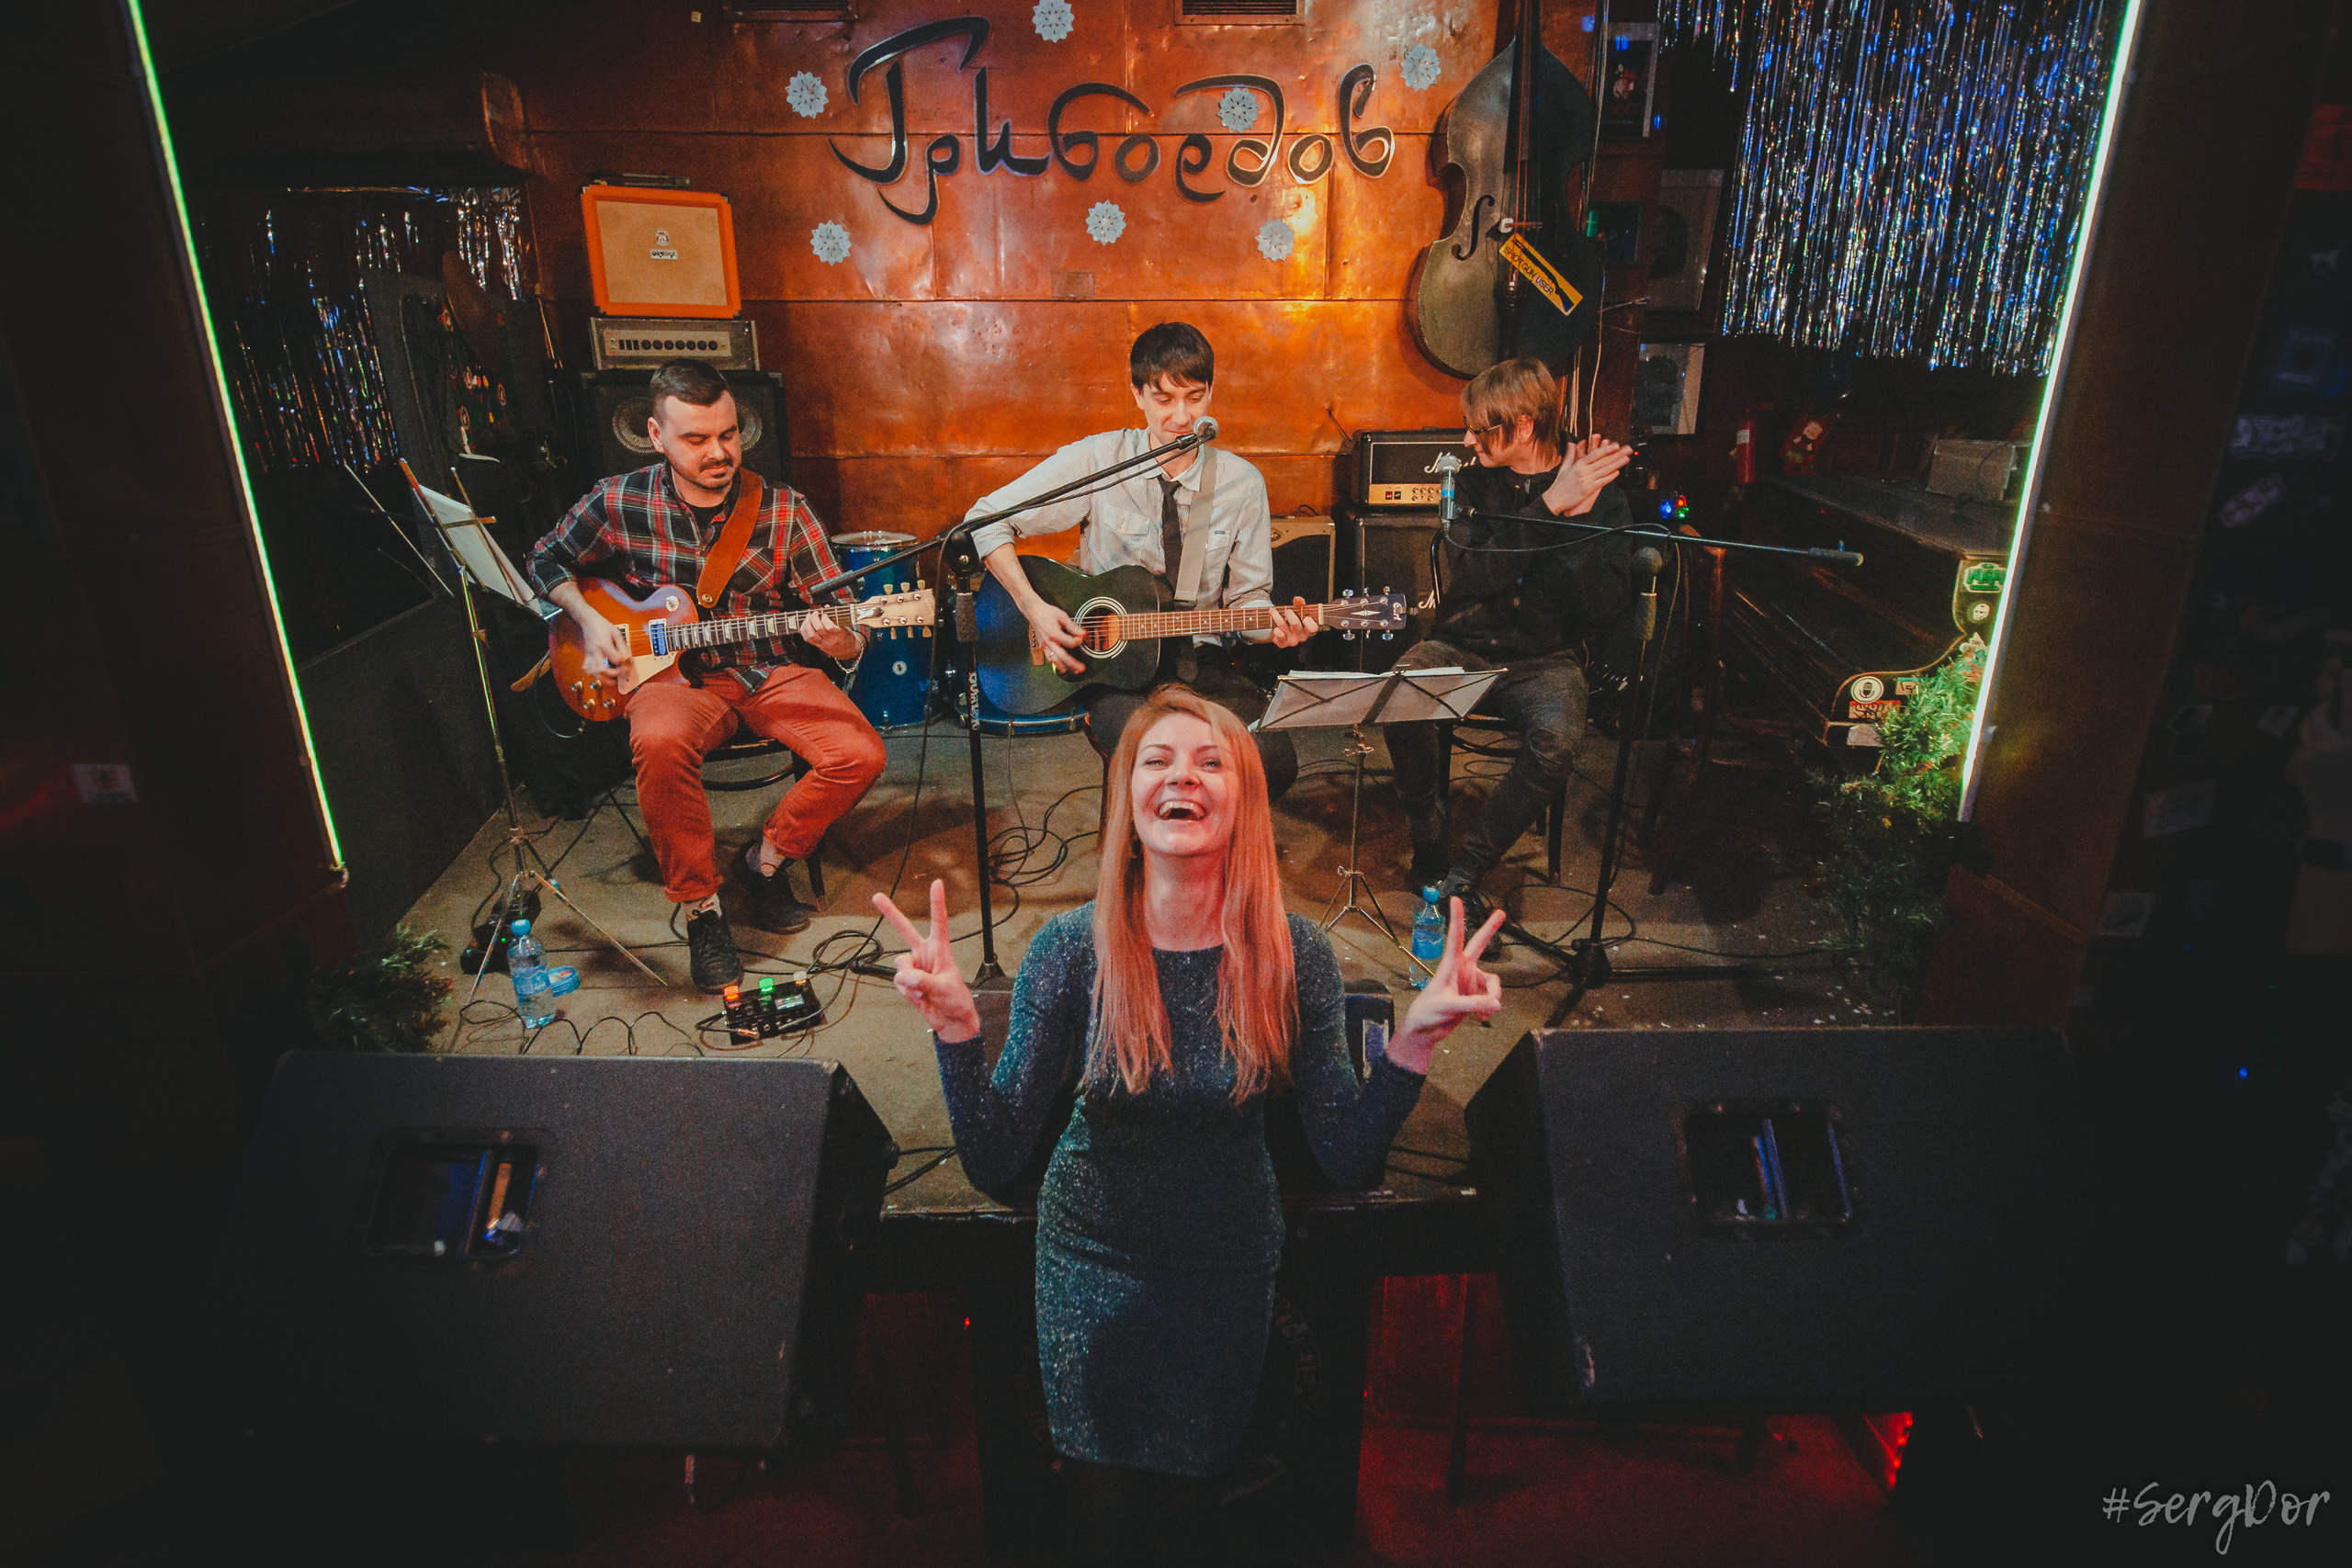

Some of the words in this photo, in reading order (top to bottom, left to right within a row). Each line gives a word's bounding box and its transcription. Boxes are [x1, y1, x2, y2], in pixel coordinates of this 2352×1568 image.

[827, 17, 1396, 226] Грибоедов
[1504, 246, 1536, 278] SHOTGUN
[1535, 277, 1554, 295] USER
